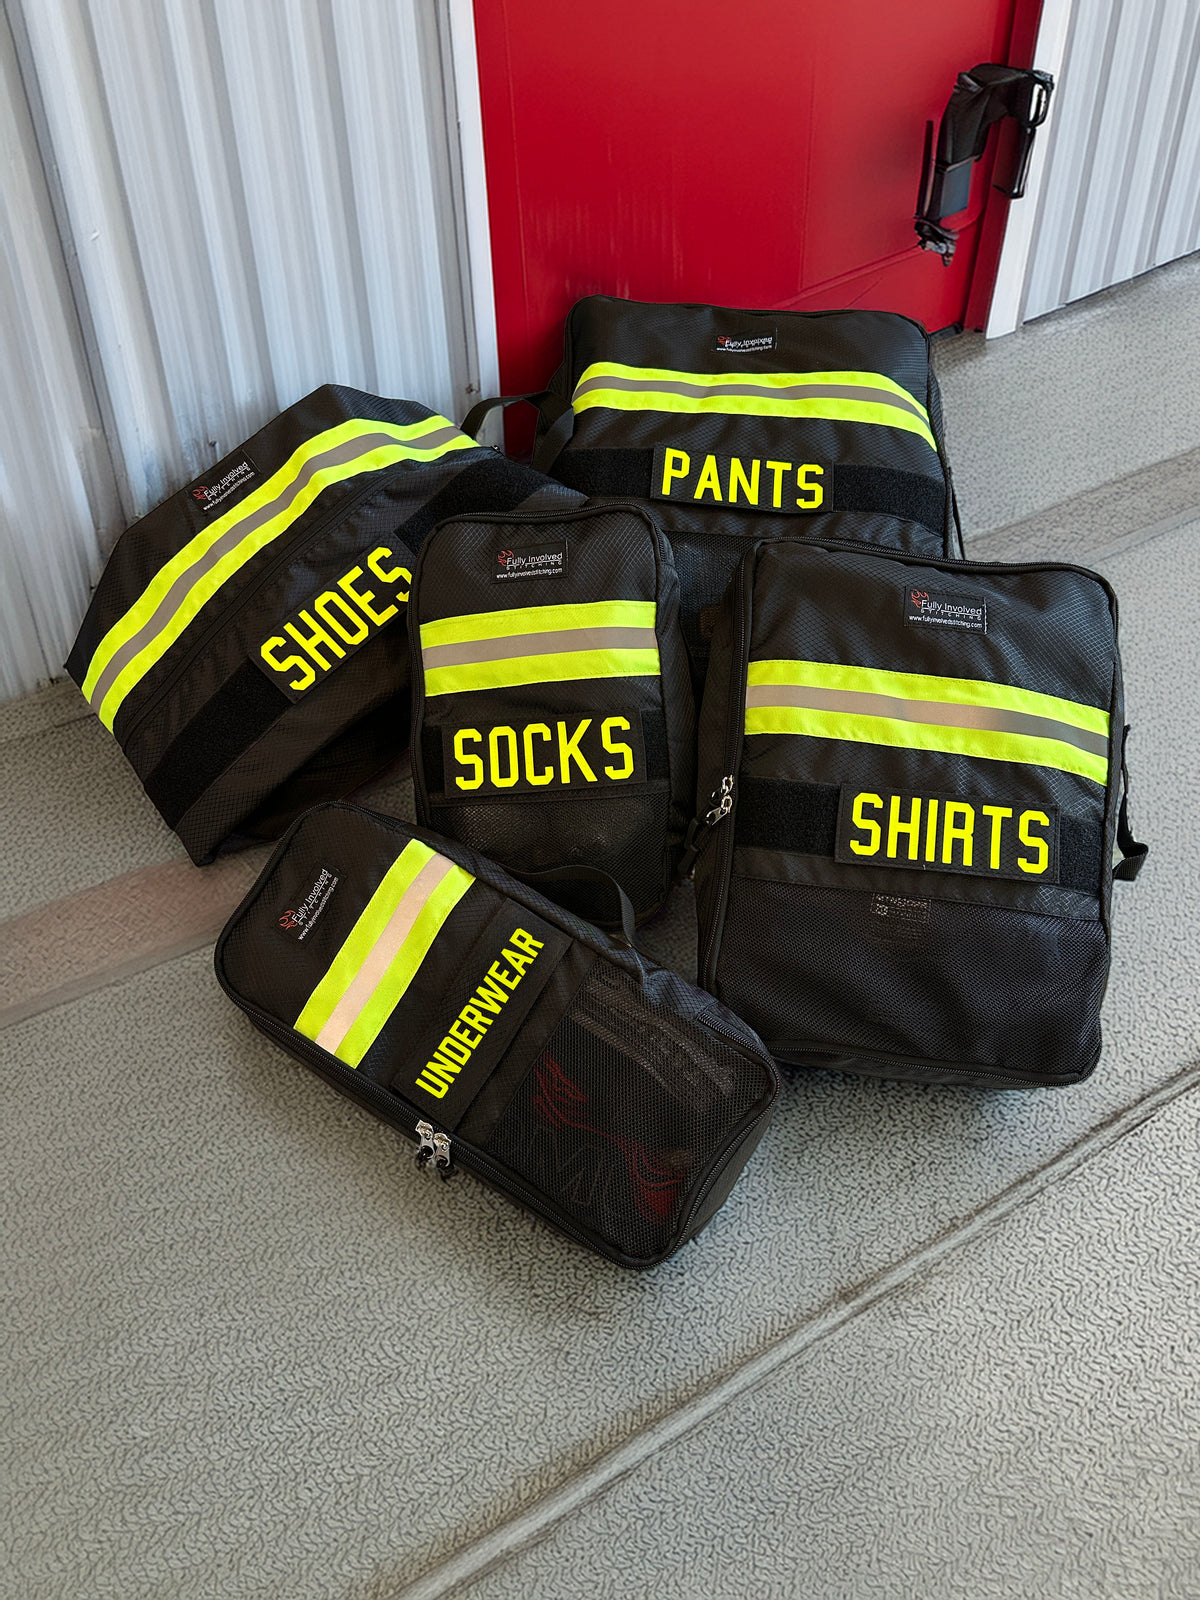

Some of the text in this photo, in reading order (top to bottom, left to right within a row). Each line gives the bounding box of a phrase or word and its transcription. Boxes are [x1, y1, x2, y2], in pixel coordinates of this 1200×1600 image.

[203, 461, 249, 498] Fully Involved
[661, 447, 824, 510] PANTS
[506, 552, 563, 566] Fully Involved
[260, 546, 413, 691] SHOES
[921, 599, 982, 616] Fully Involved
[453, 715, 635, 791] SOCKS
[849, 792, 1050, 875] SHIRTS
[291, 868, 328, 923] Fully Involved
[414, 927, 545, 1099] UNDERWEAR
